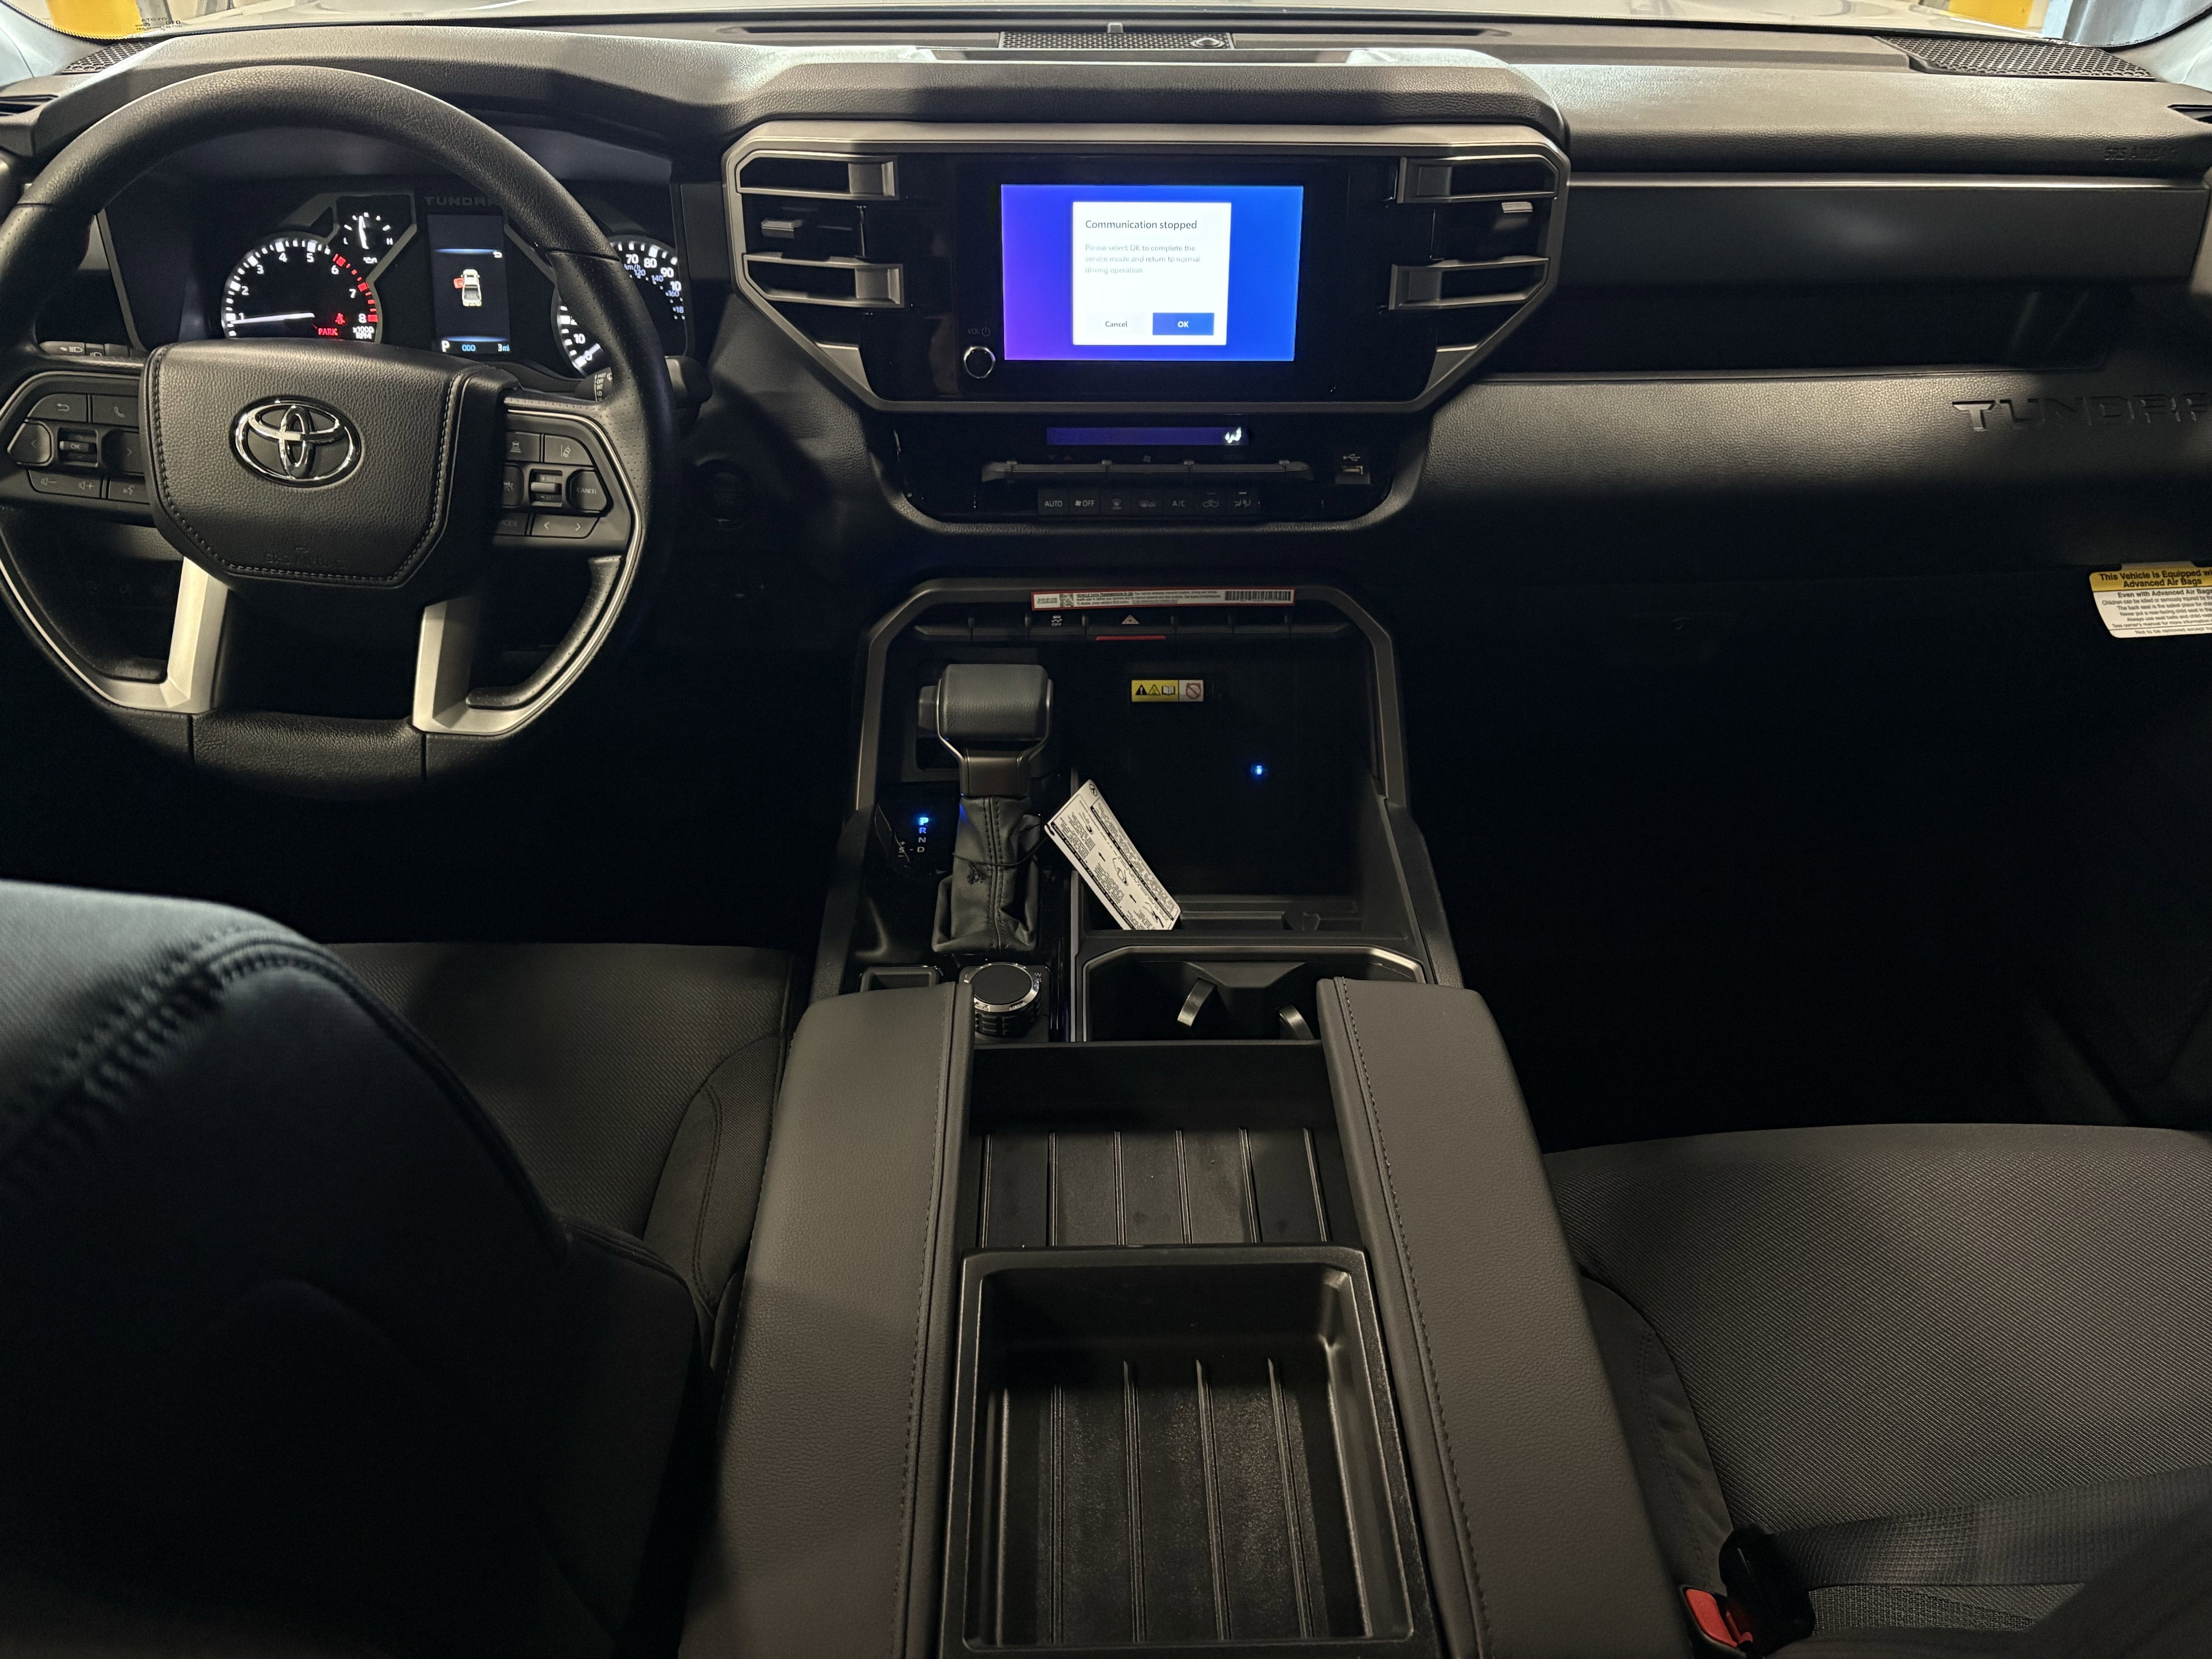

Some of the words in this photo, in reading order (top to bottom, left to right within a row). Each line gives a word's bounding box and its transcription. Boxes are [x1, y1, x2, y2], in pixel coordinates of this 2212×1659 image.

[1085, 220, 1157, 229] Communication
[1160, 220, 1197, 230] stopped
[279, 253, 287, 262] 4
[307, 253, 314, 262] 5
[626, 254, 639, 264] 70
[644, 258, 657, 268] 80
[257, 265, 264, 274] 3
[331, 266, 338, 275] 6
[660, 267, 674, 278] 90
[242, 286, 249, 295] 2
[670, 281, 682, 291] 10
[349, 289, 356, 298] 7
[359, 314, 366, 323] 8
[573, 333, 586, 344] 10
[442, 340, 450, 352] P
[2119, 572, 2150, 580] Vehicle
[2162, 570, 2201, 580] Equipped
[2181, 577, 2202, 586] Bags
[919, 817, 929, 825] P
